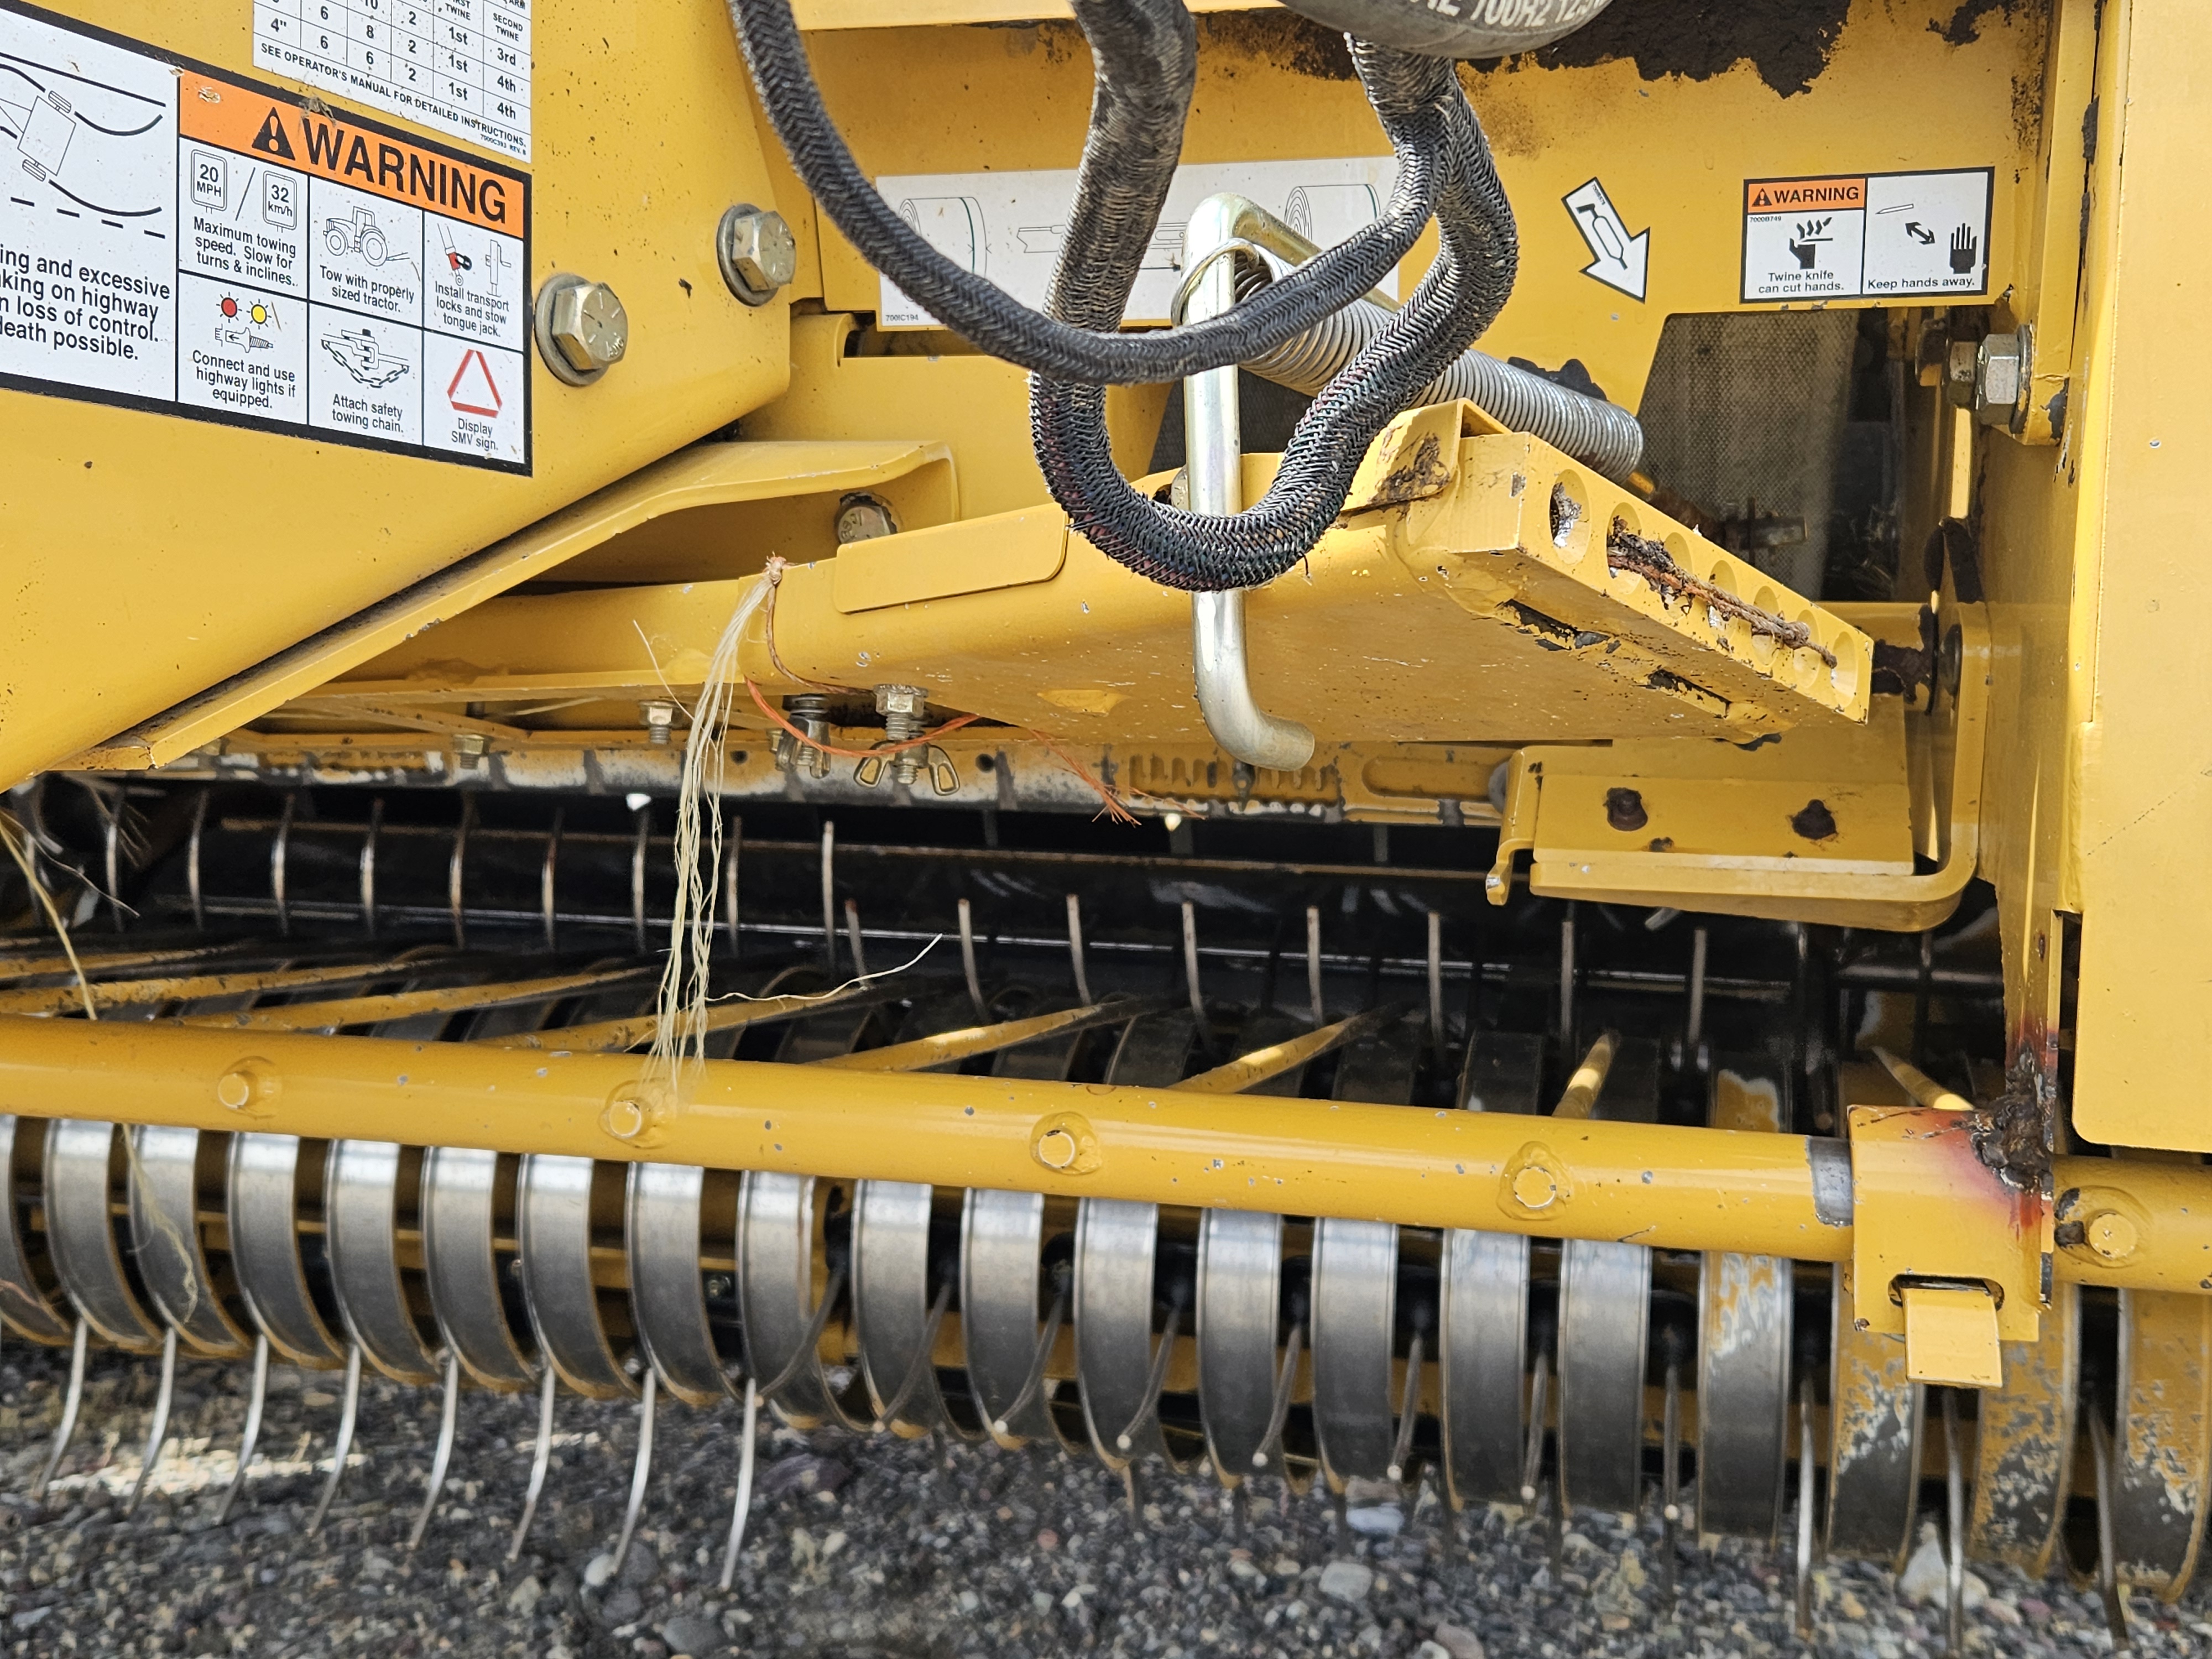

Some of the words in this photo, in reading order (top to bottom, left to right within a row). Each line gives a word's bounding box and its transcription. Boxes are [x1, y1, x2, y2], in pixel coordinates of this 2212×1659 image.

[445, 2, 471, 20] TWINE
[493, 13, 523, 32] SECOND
[409, 11, 416, 25] 2
[449, 27, 468, 45] 1st
[497, 48, 516, 66] 3rd
[495, 25, 519, 41] TWINE
[320, 6, 328, 20] 6
[366, 25, 374, 39] 8
[409, 39, 416, 54] 2
[448, 55, 468, 73] 1st
[497, 75, 516, 93] 4th
[270, 18, 287, 32] 4"
[320, 35, 328, 49] 6
[366, 51, 374, 65] 6
[409, 67, 416, 82] 2
[449, 82, 468, 101] 1st
[497, 102, 516, 119] 4th
[261, 43, 281, 58] SEE
[284, 51, 347, 81] OPERATOR'S
[351, 75, 391, 97] MANUAL
[394, 90, 413, 106] FOR
[415, 98, 458, 122] DETAILED
[461, 116, 526, 147] INSTRUCTIONS.
[200, 164, 219, 182] 20
[302, 118, 505, 224] WARNING
[197, 181, 222, 197] MPH
[271, 184, 289, 203] 32
[1773, 186, 1859, 204] WARNING
[268, 201, 293, 217] km/h
[194, 216, 253, 244] Maximum
[257, 233, 296, 258] towing
[195, 236, 236, 256] speed.
[244, 245, 273, 265] Slow
[276, 254, 293, 270] for
[36, 257, 72, 278] and
[79, 267, 170, 299] excessive
[197, 251, 229, 270] turns
[233, 259, 242, 274] &
[246, 262, 295, 286] inclines.
[1768, 272, 1802, 282] Twine
[1805, 270, 1834, 280] knife
[0, 269, 44, 301] king
[51, 284, 75, 302] on
[82, 285, 159, 324] highway
[320, 264, 342, 281] Tow
[345, 273, 368, 290] with
[371, 281, 415, 304] properly
[435, 281, 464, 300] Install
[467, 290, 510, 313] transport
[1758, 285, 1779, 294] can
[1783, 283, 1801, 293] cut
[1804, 281, 1844, 292] hands.
[1867, 279, 1898, 290] Keep
[1901, 277, 1938, 288] hands
[1942, 278, 1975, 288] away.
[332, 285, 360, 302] sized
[363, 291, 401, 313] tractor.
[437, 296, 462, 314] locks
[465, 305, 483, 319] and
[485, 309, 507, 325] stow
[17, 295, 57, 322] loss
[64, 307, 83, 326] of
[88, 315, 159, 342] control.
[444, 313, 477, 332] tongue
[479, 322, 501, 337] jack.
[0, 315, 46, 343] eath
[54, 330, 138, 360] possible.
[192, 349, 244, 372] Connect
[248, 364, 270, 377] and
[274, 368, 295, 382] use
[196, 366, 248, 391] highway
[252, 377, 285, 395] lights
[289, 384, 296, 398] if
[212, 388, 273, 408] equipped.
[332, 394, 368, 411] Attach
[371, 403, 403, 421] safety
[332, 409, 369, 430] towing
[372, 416, 404, 434] chain.
[458, 418, 493, 438] Display
[451, 431, 473, 446] SMV
[476, 436, 499, 451] sign.
